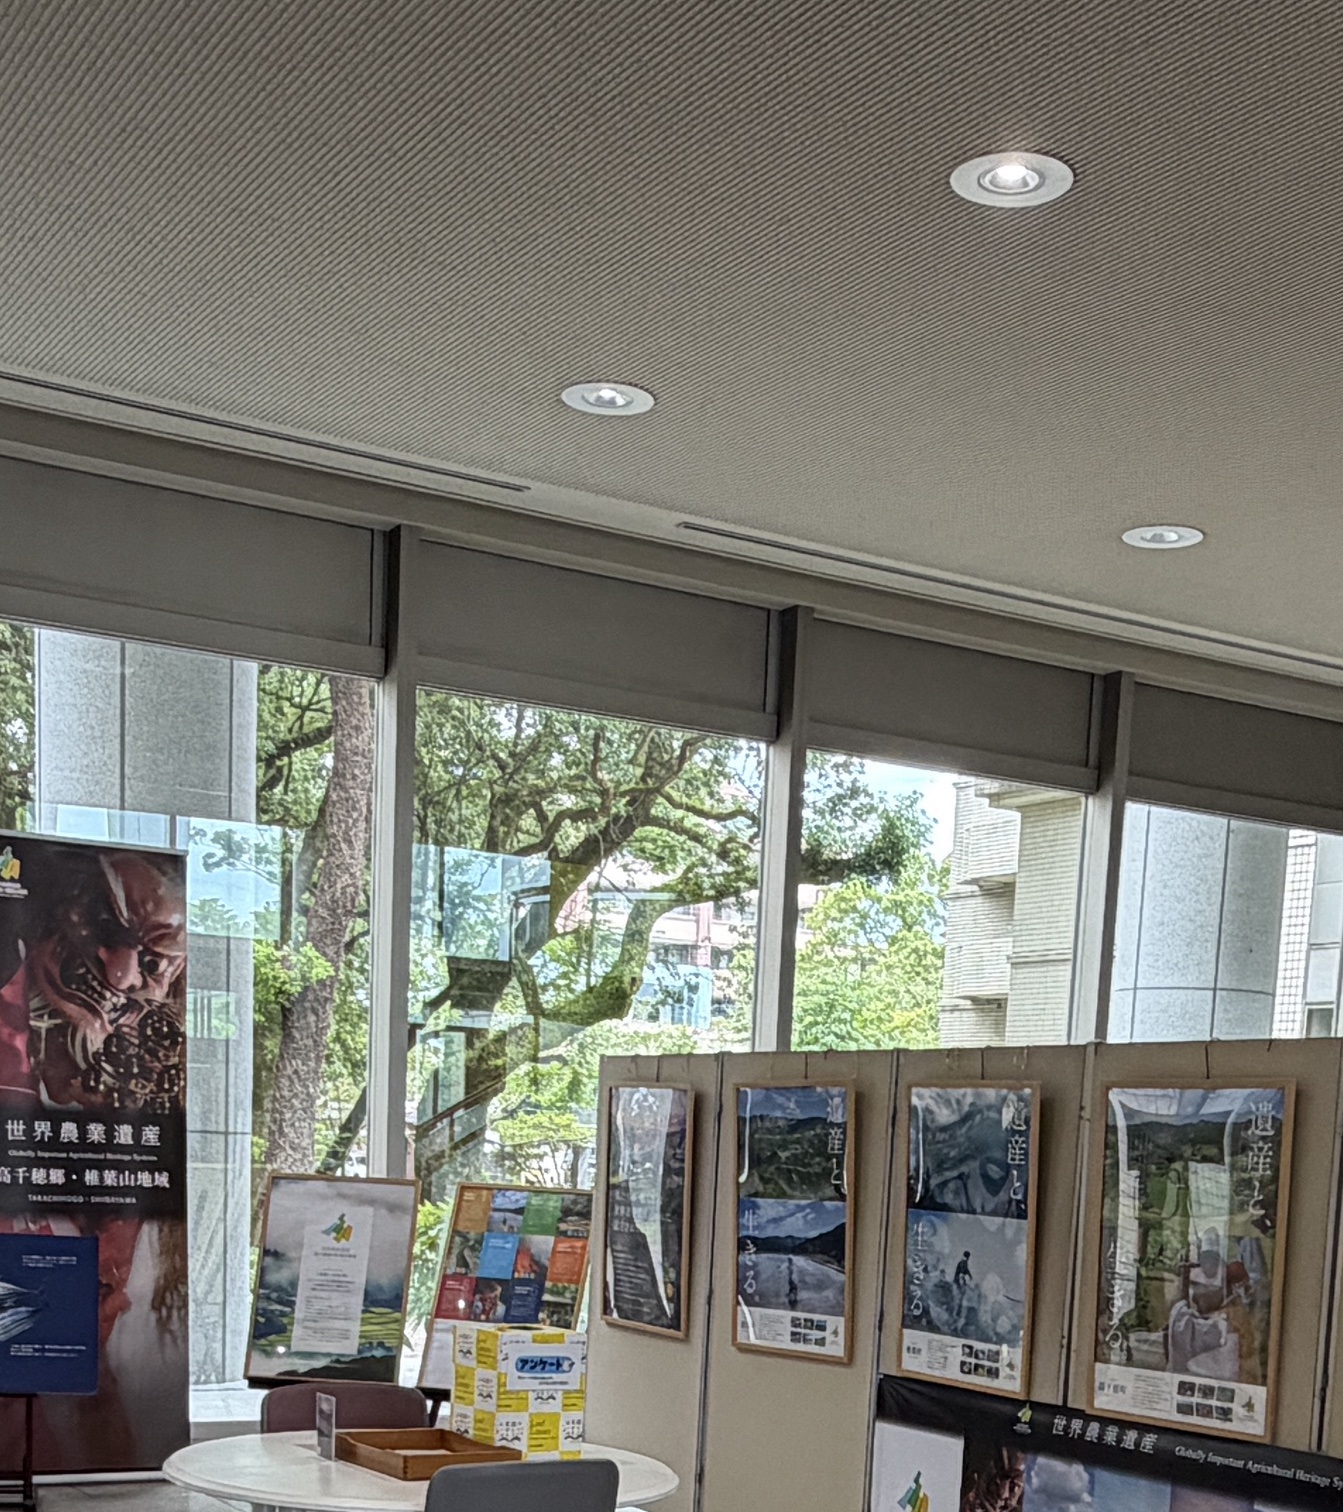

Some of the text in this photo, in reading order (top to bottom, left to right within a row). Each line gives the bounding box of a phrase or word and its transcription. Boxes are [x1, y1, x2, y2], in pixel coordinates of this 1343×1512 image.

[5, 1119, 162, 1147] 世界農業遺産
[1052, 1413, 1159, 1455] 世界農業遺産
[1207, 1451, 1246, 1471] Important
[1247, 1460, 1295, 1479] Agricultural
[1296, 1468, 1331, 1489] Heritage
